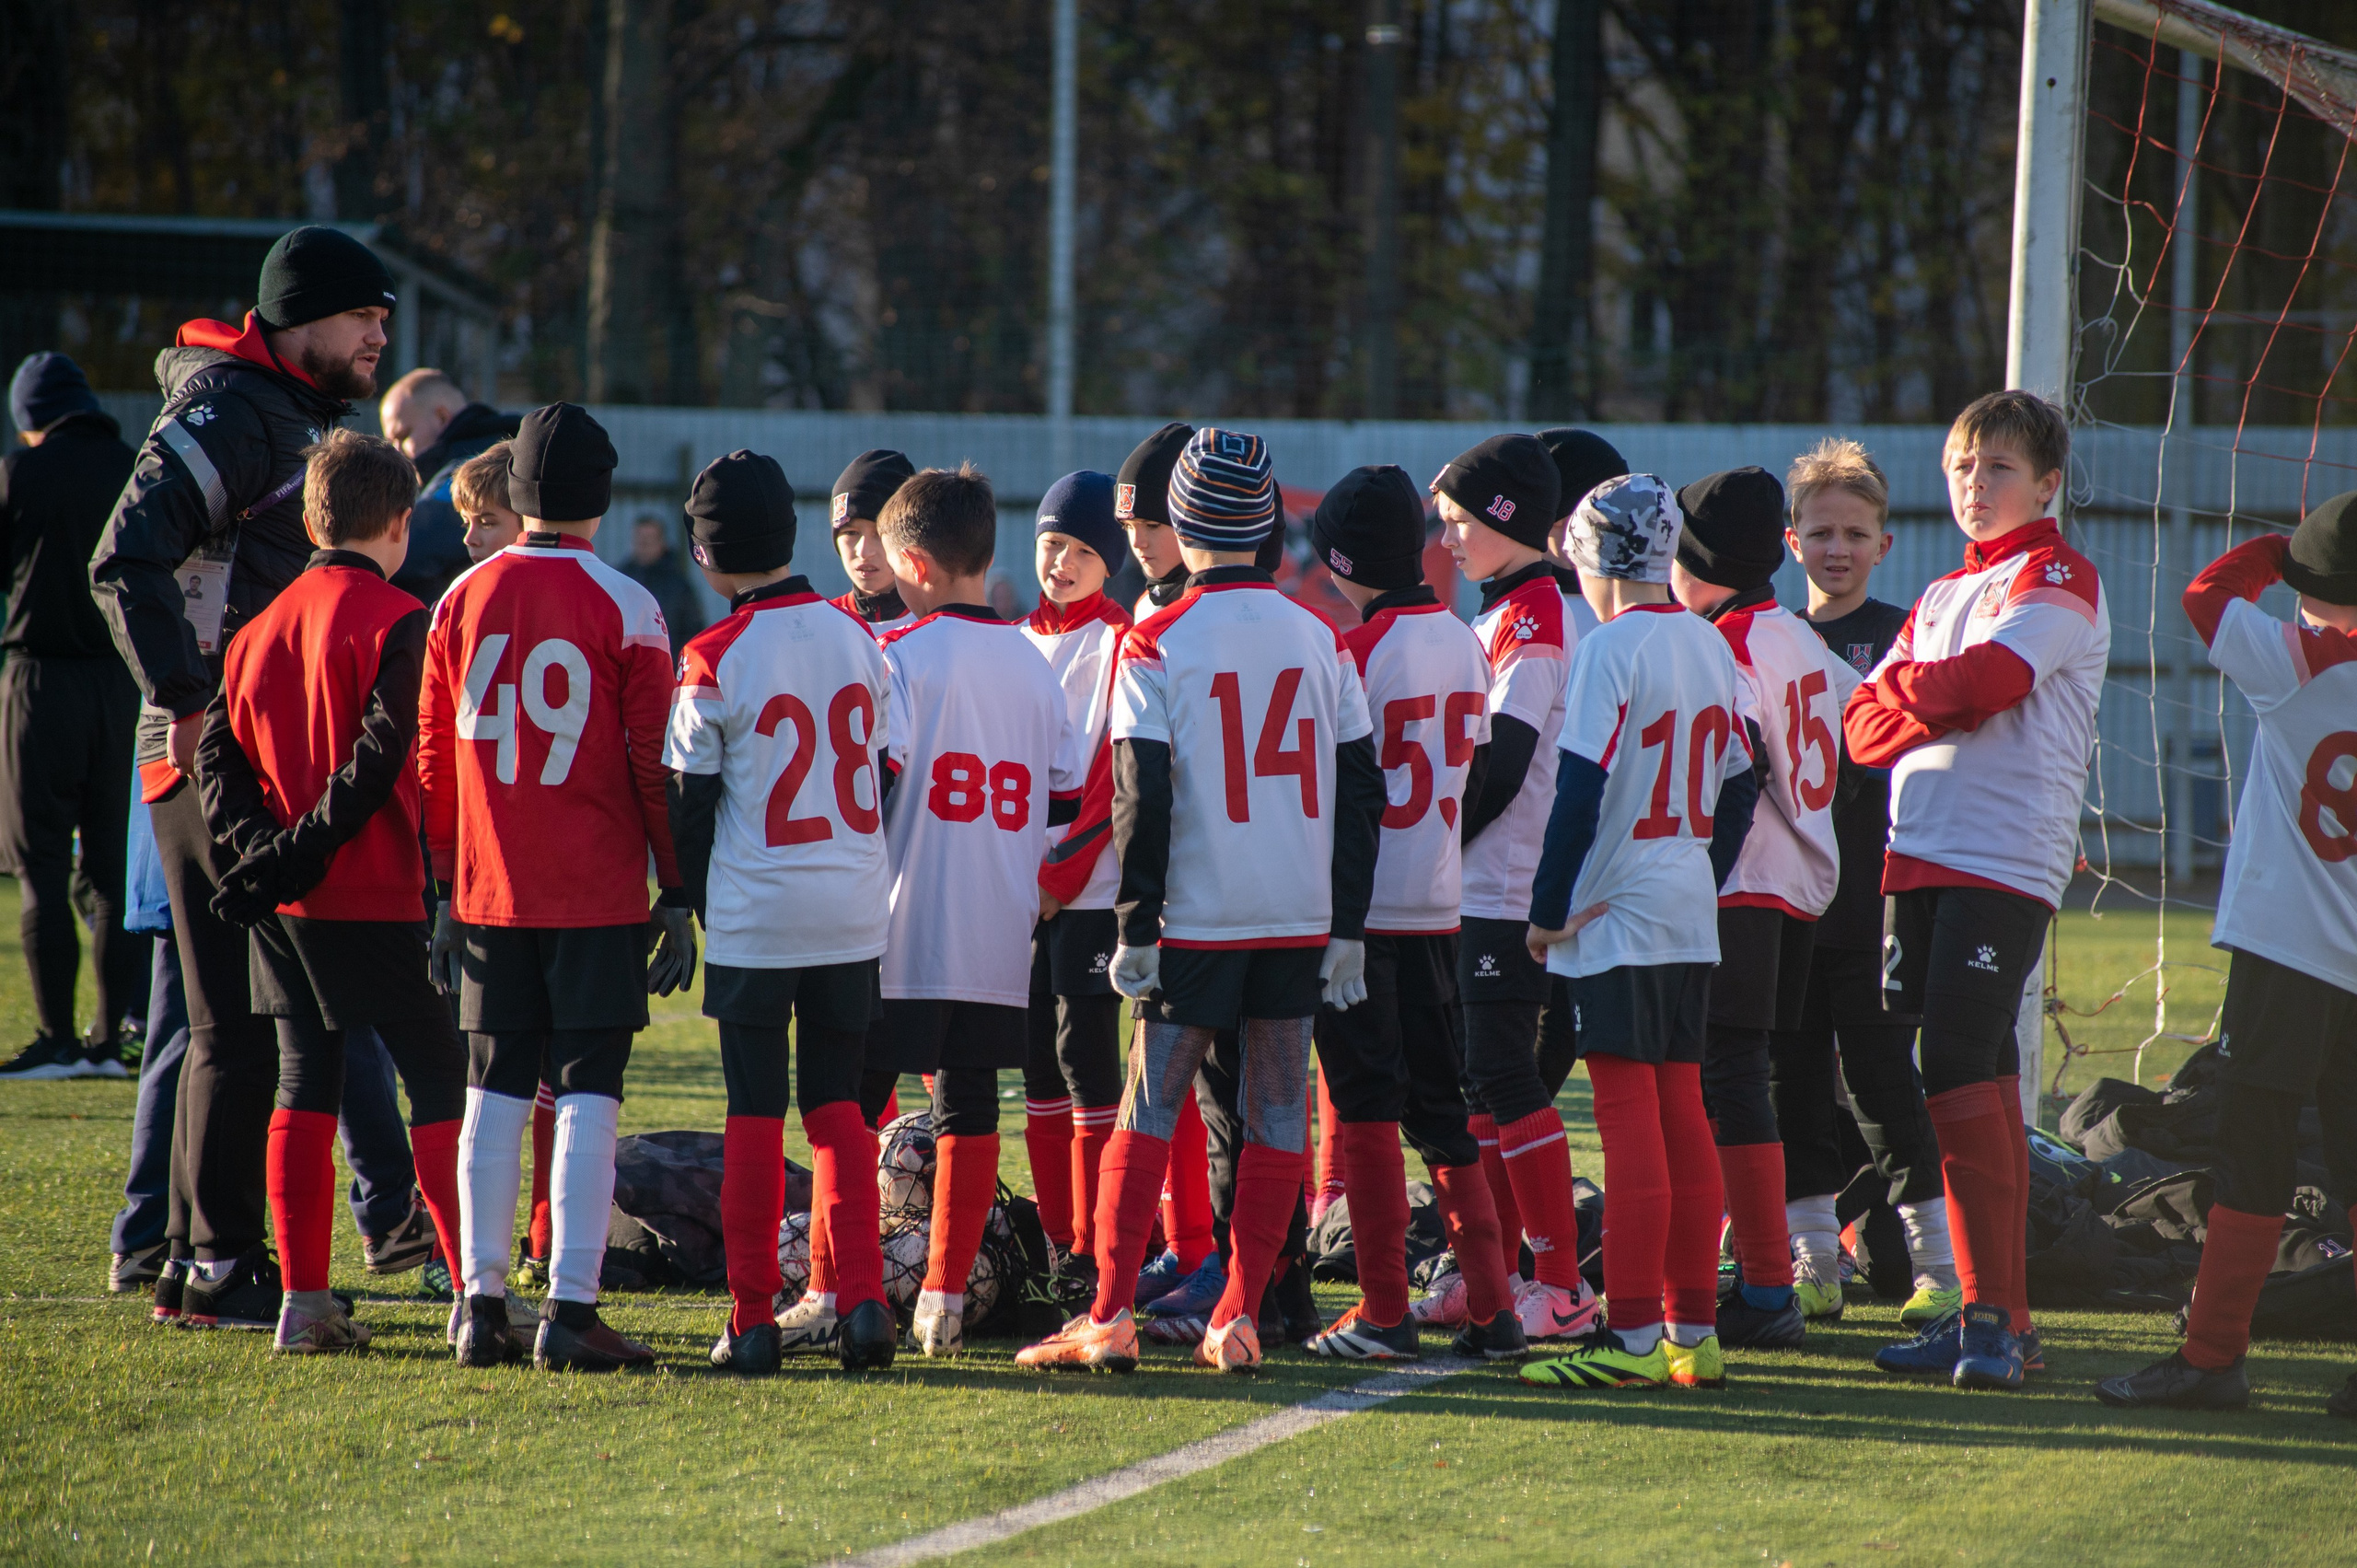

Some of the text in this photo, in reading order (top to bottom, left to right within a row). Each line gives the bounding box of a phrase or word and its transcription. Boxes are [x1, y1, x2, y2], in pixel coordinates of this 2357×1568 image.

[275, 475, 304, 498] FIFA.com
[1487, 494, 1515, 521] 18
[1329, 547, 1353, 575] 55
[456, 633, 592, 786] 49
[1210, 668, 1318, 823] 14
[1379, 691, 1486, 832] 55
[1784, 669, 1839, 819] 15
[754, 683, 880, 847] 28
[928, 751, 1032, 832] 88
[1632, 704, 1731, 841] 10
[1968, 959, 2000, 973] KELME
[2318, 1238, 2347, 1259] 11
